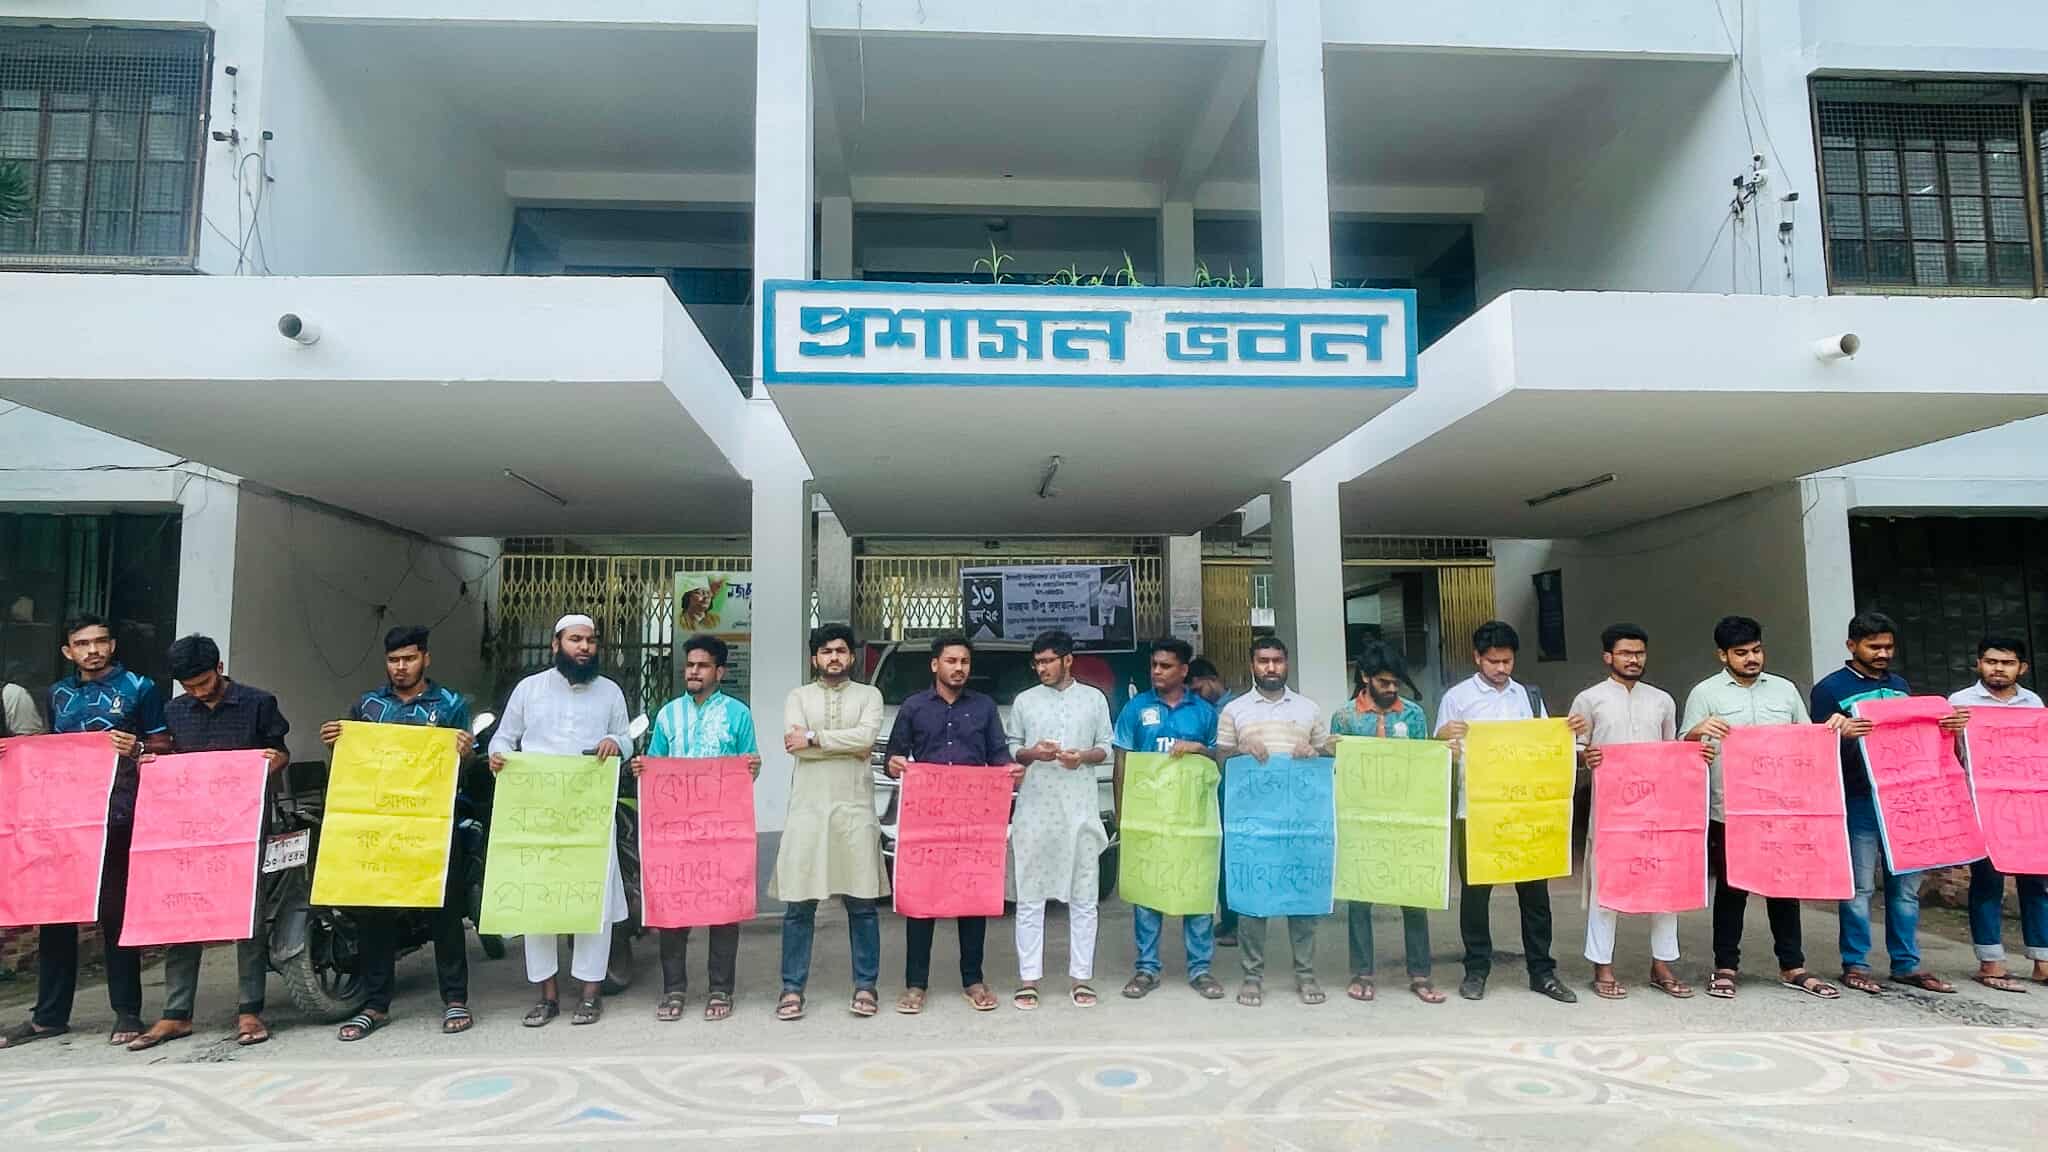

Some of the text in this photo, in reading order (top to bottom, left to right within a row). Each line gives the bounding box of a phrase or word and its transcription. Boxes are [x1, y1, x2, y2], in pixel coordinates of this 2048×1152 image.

[799, 305, 1390, 363] প্রশাসন ভবন
[971, 584, 996, 607] ১৩
